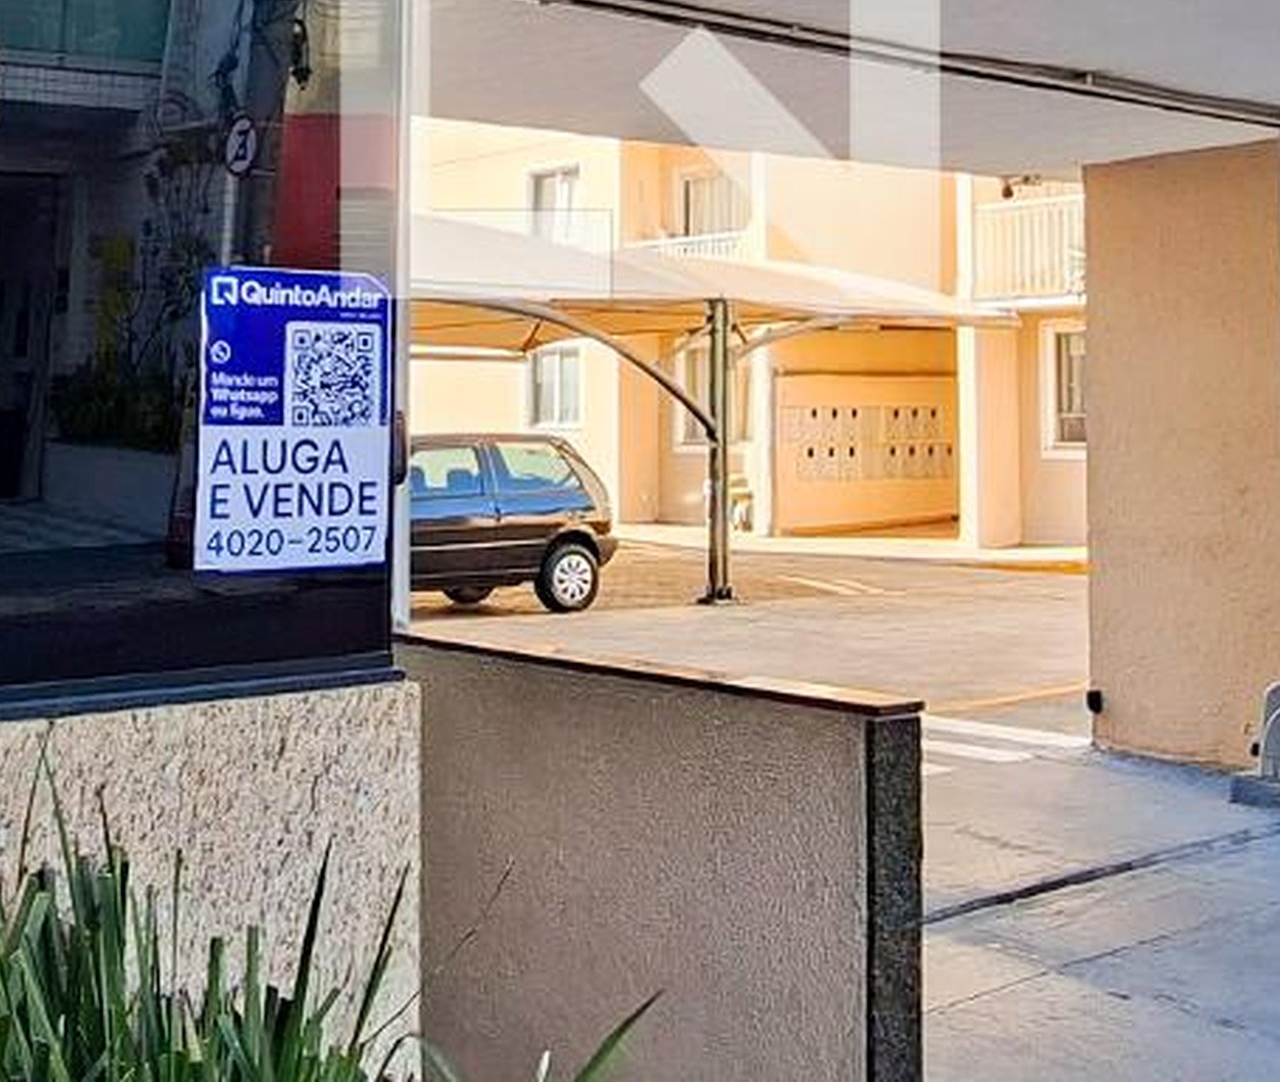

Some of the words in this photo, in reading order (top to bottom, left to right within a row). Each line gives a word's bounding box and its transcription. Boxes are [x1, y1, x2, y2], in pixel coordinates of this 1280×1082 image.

[240, 279, 383, 309] QuintoAndar
[209, 438, 349, 475] ALUGA
[209, 483, 231, 519] E
[243, 481, 378, 519] VENDE
[206, 525, 378, 557] 4020-2507
